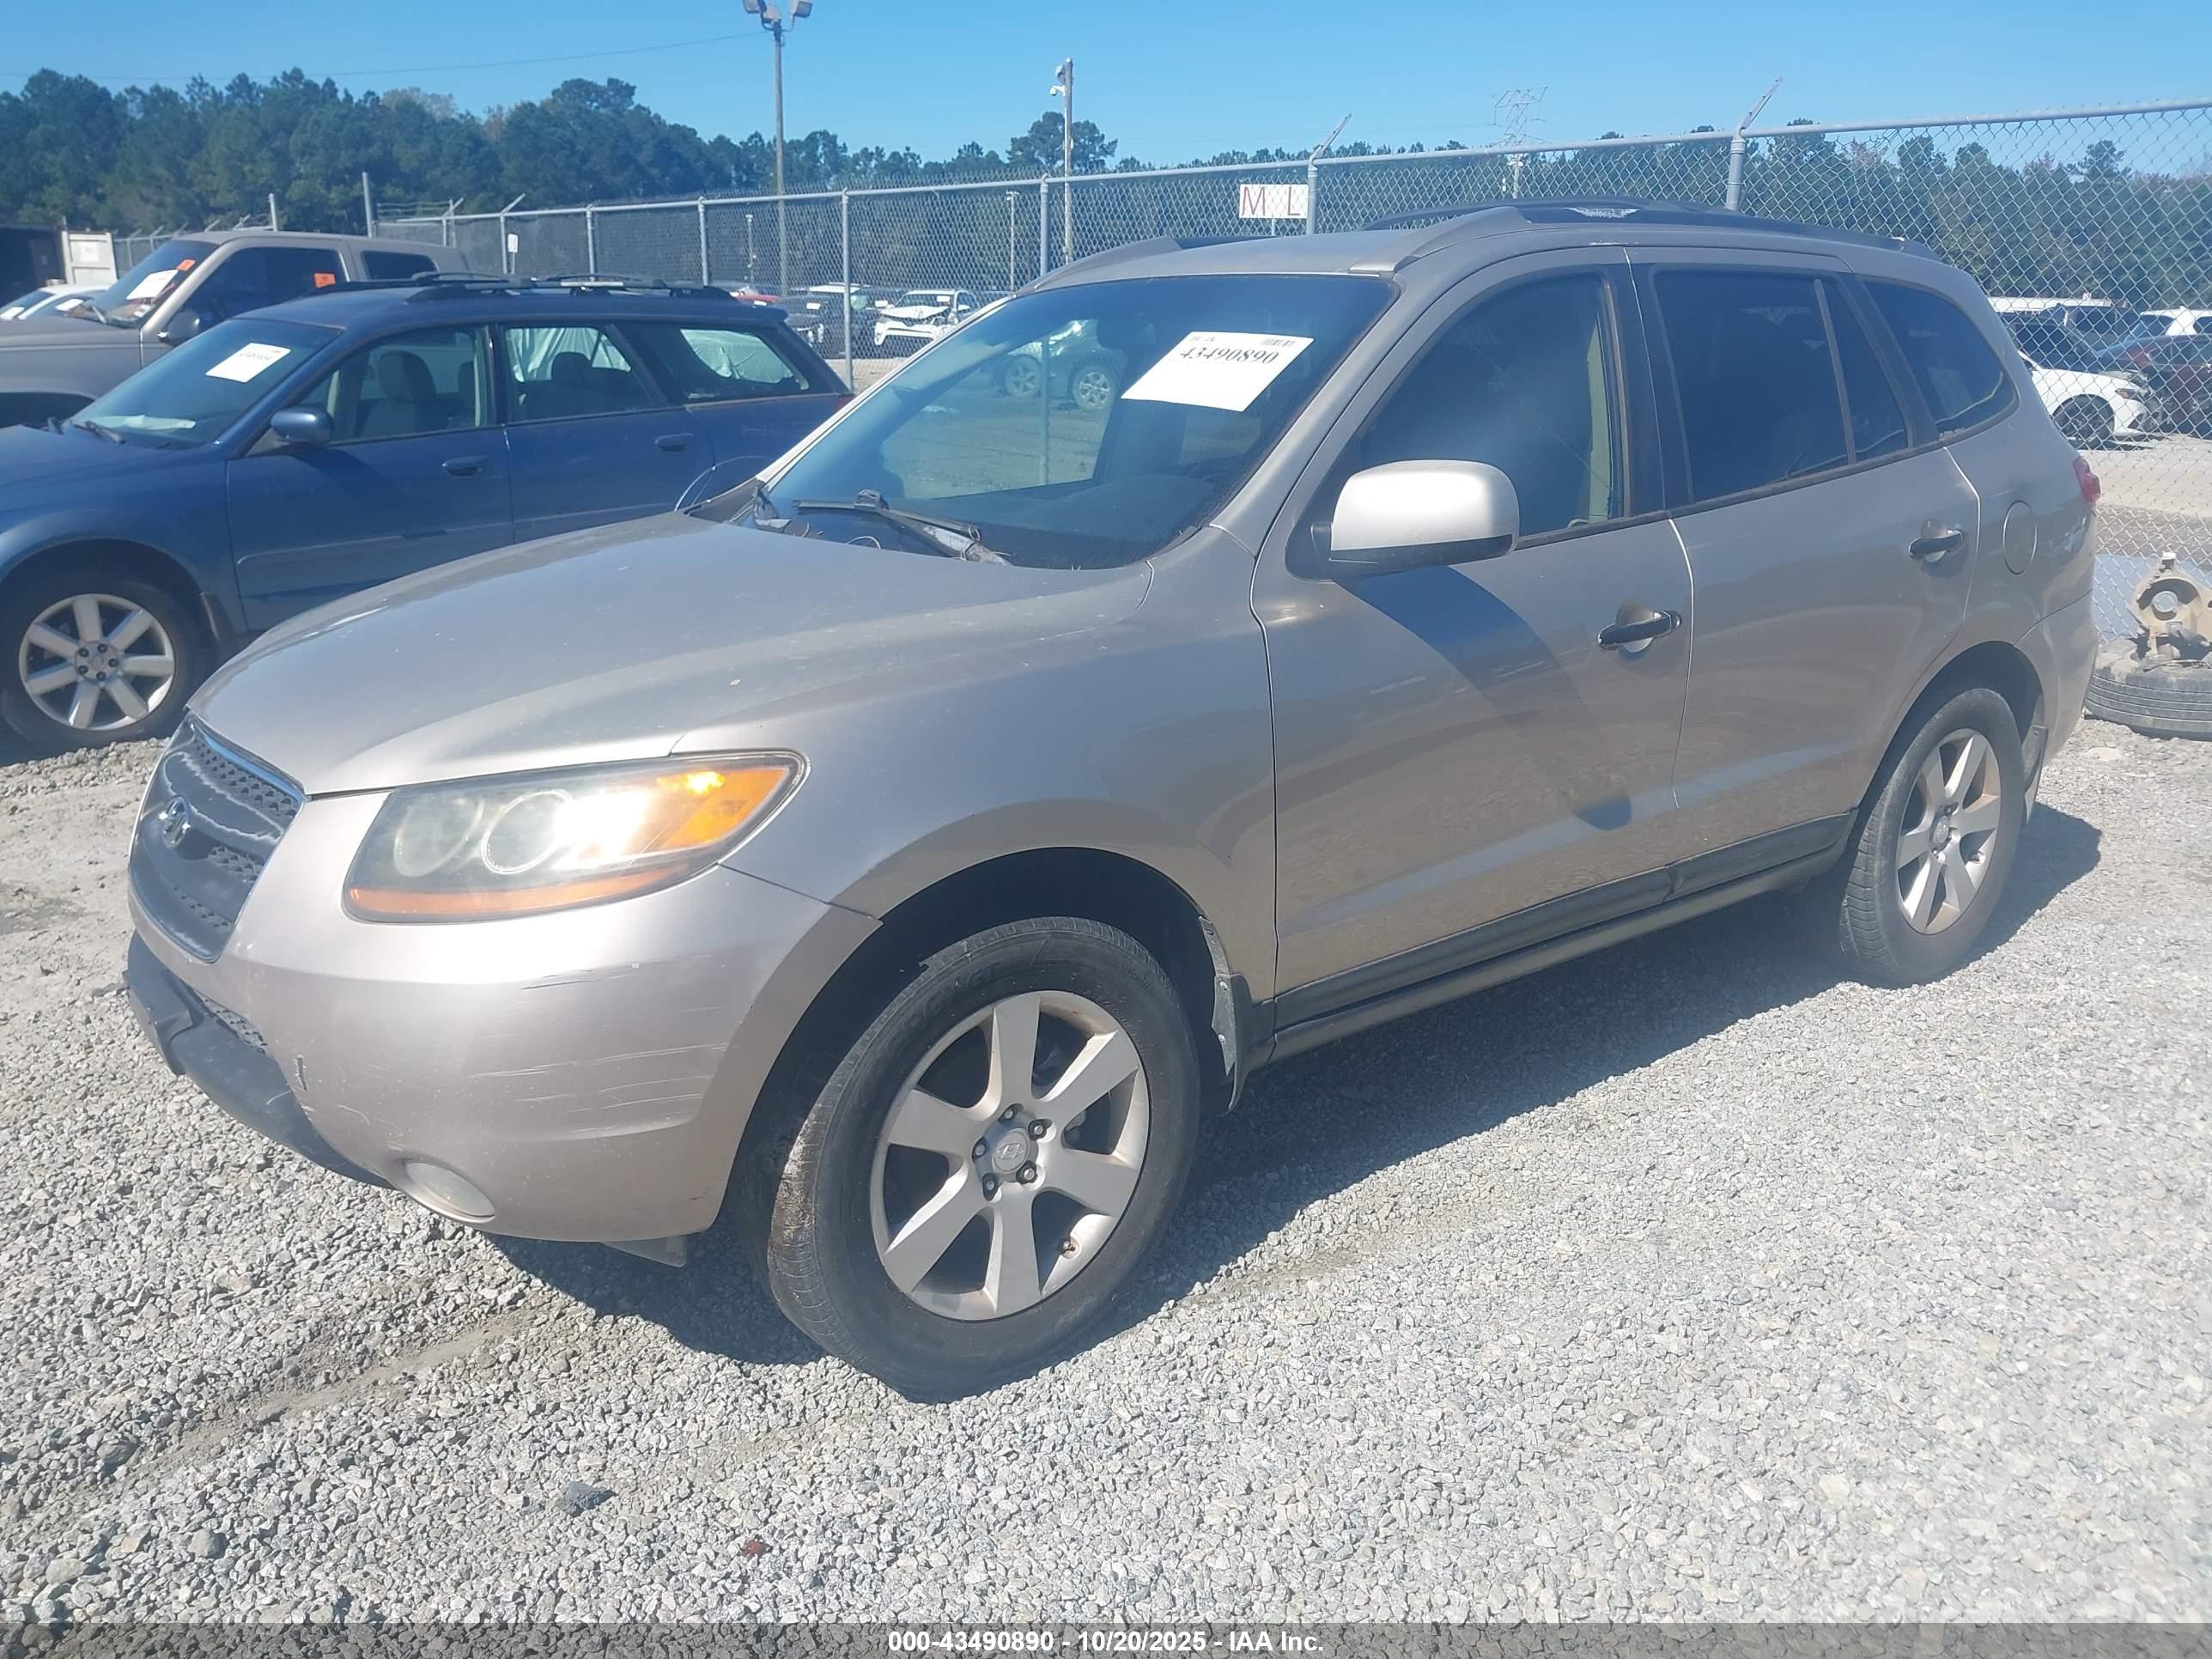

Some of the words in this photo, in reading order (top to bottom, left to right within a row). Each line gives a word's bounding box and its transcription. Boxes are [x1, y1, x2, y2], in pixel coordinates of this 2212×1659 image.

[1242, 186, 1265, 216] M
[1287, 186, 1301, 216] L
[1180, 346, 1279, 364] 43490890
